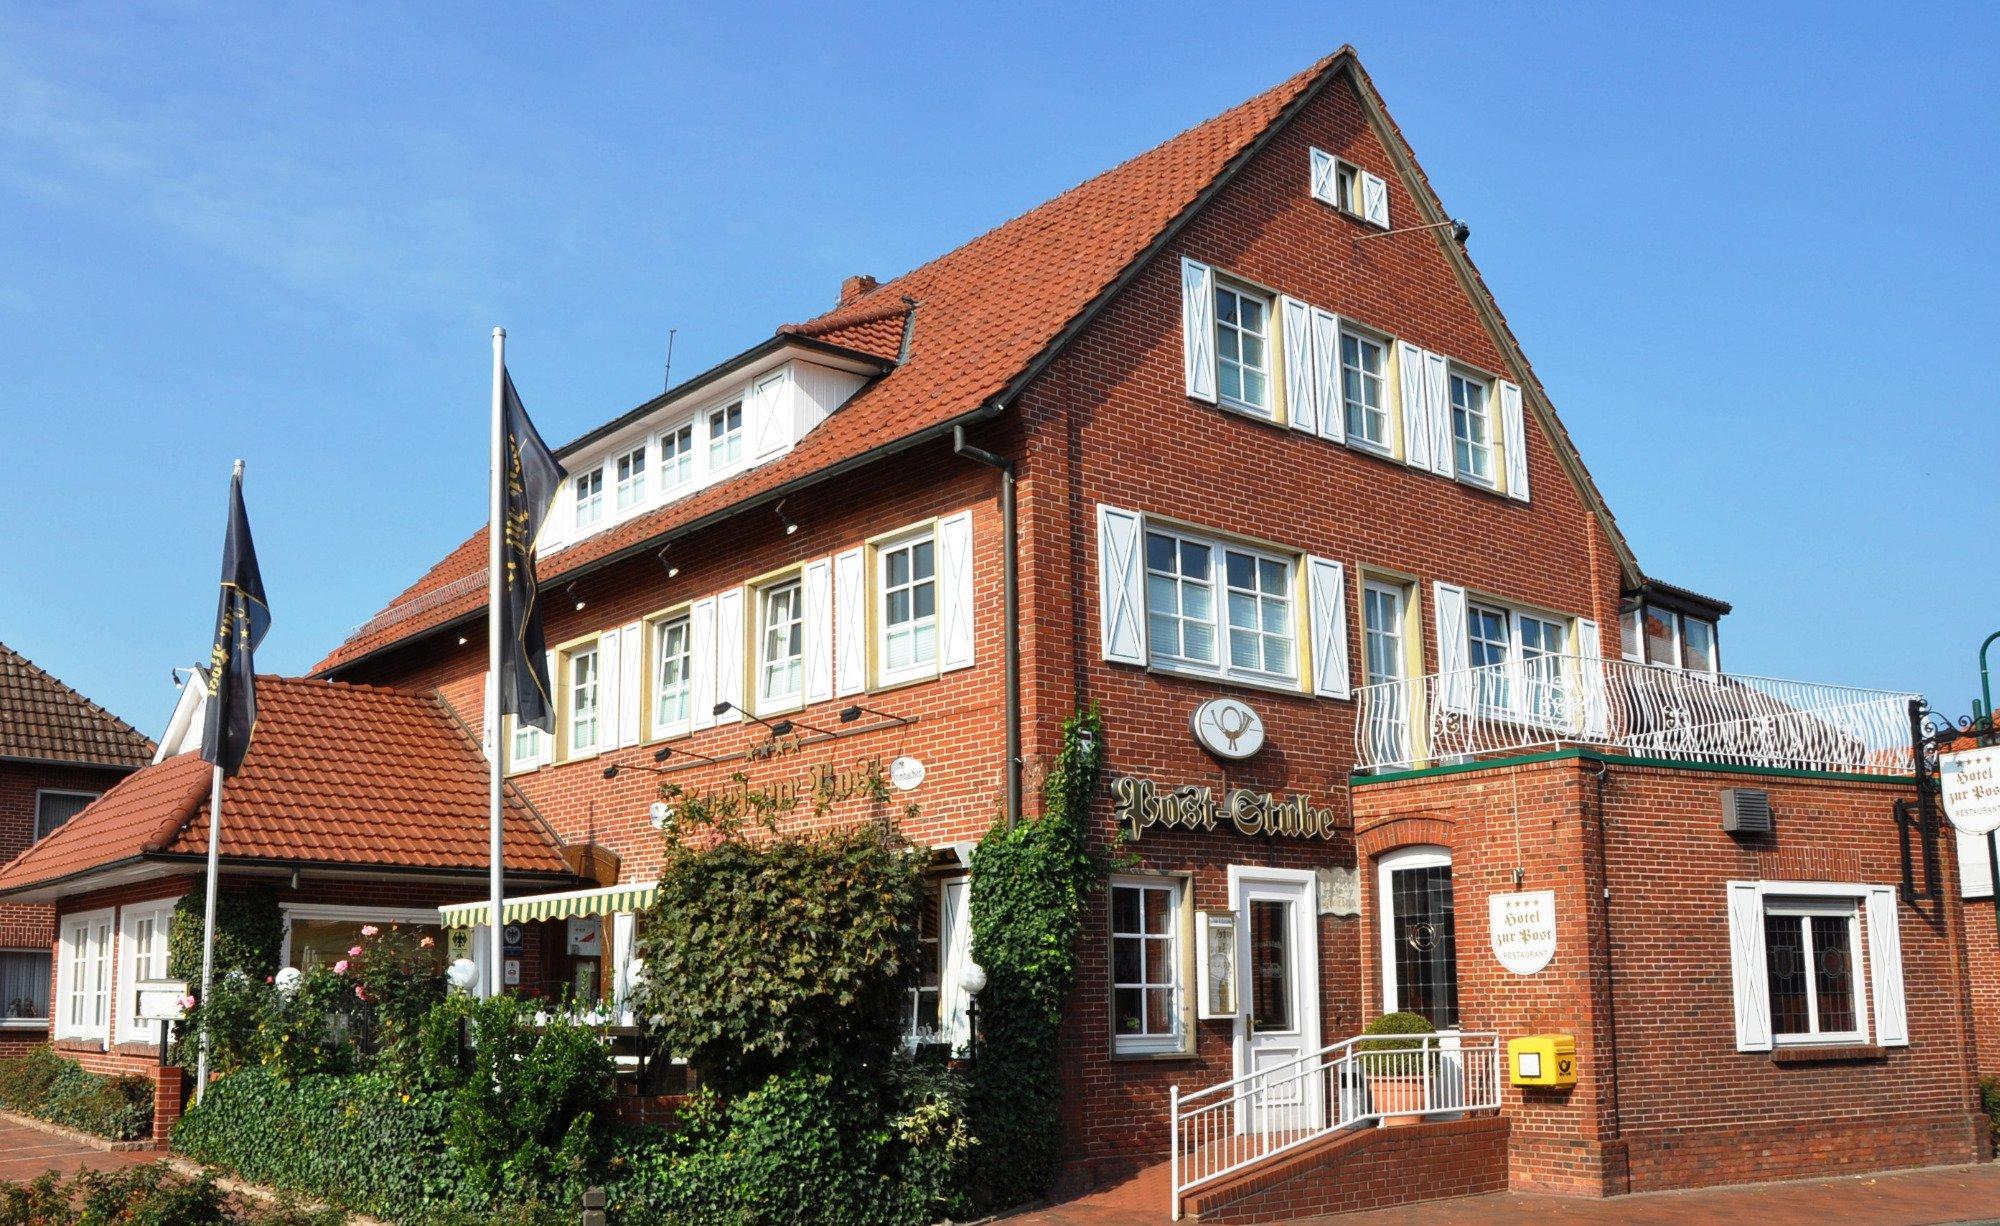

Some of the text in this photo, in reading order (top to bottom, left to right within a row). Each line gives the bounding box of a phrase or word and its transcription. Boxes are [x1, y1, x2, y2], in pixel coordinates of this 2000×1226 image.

[807, 753, 885, 807] Post
[1956, 767, 1993, 785] Hotel
[1949, 785, 2000, 806] zur Pos
[1111, 777, 1336, 841] Post-Stube
[1504, 910, 1541, 927] Hotel
[1496, 928, 1552, 947] zur Post
[1503, 949, 1548, 960] RESTAURANT
